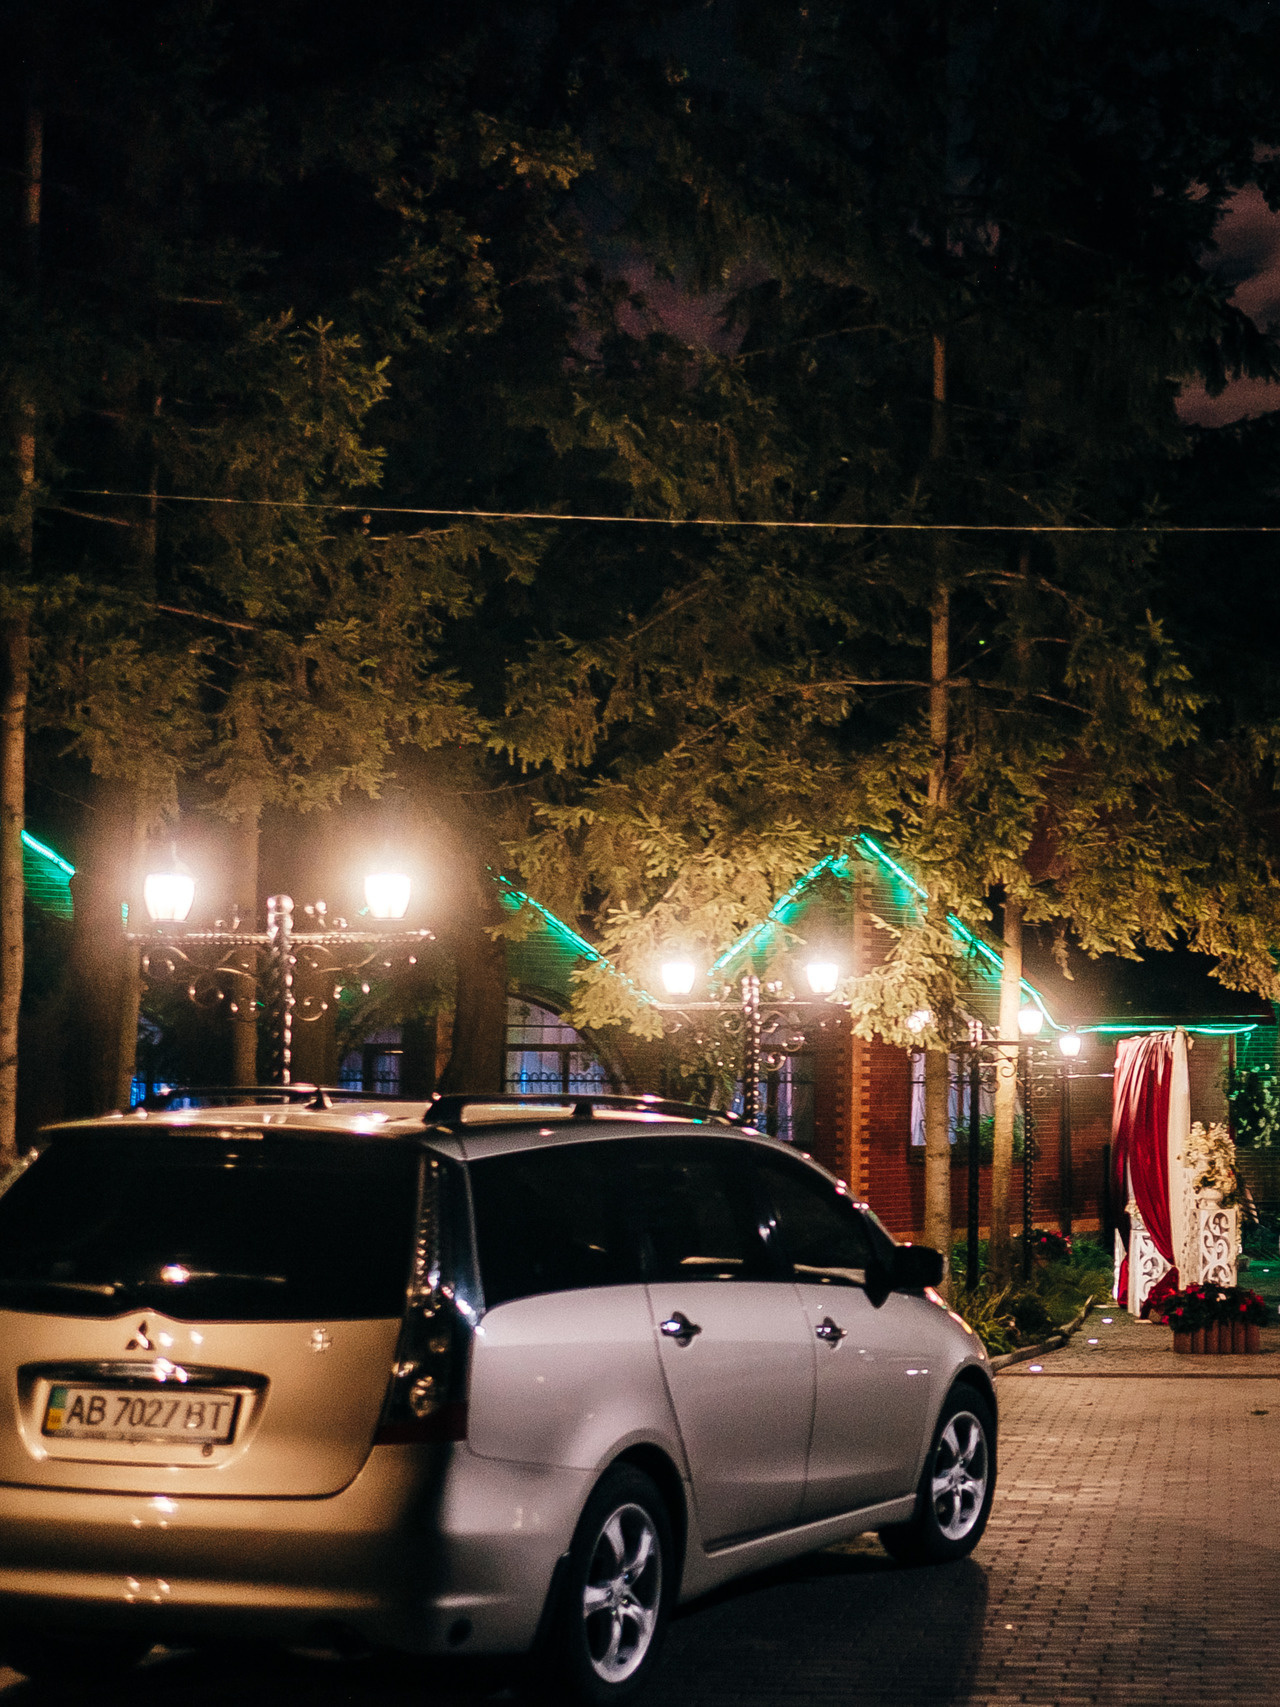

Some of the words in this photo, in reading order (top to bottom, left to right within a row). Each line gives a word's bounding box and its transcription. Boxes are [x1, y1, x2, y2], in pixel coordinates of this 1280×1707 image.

[66, 1394, 107, 1426] AB
[113, 1396, 180, 1429] 7027
[183, 1400, 230, 1432] BT
